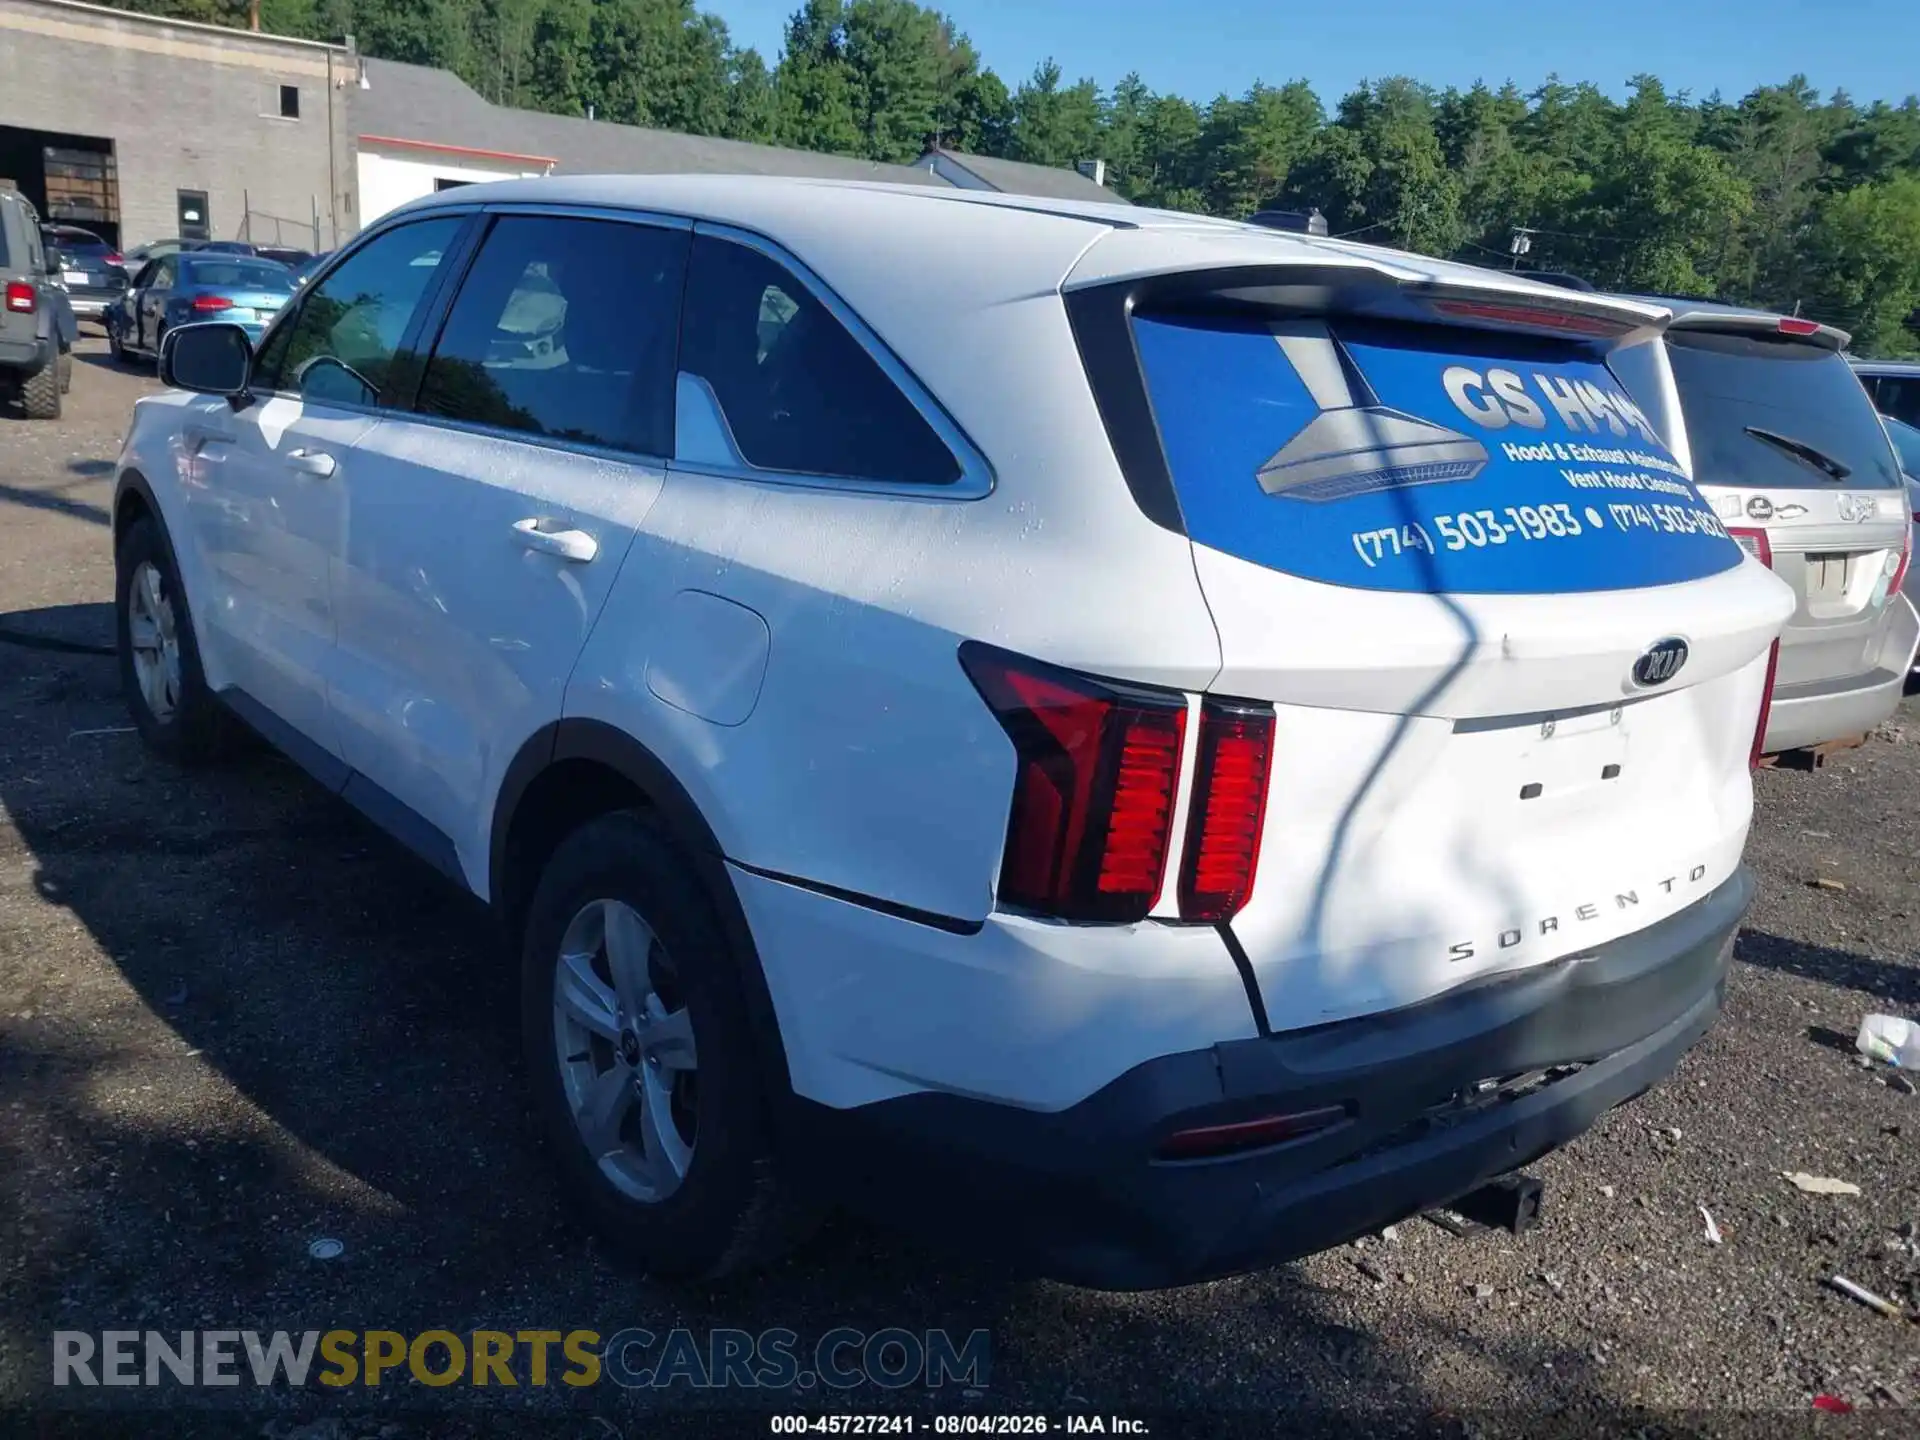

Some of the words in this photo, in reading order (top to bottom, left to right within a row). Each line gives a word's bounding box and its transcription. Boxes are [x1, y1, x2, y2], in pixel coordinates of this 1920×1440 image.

[1442, 366, 1547, 430] GS
[1501, 441, 1556, 462] Hood
[1553, 442, 1570, 461] &
[1567, 442, 1630, 465] Exhaust
[1560, 469, 1605, 489] Vent
[1600, 470, 1644, 491] Hood
[1352, 521, 1435, 567] (774)
[1434, 503, 1582, 551] 503-1983
[1608, 503, 1659, 532] (774)
[1644, 647, 1684, 679] KIA
[1448, 864, 1706, 962] SORENTO
